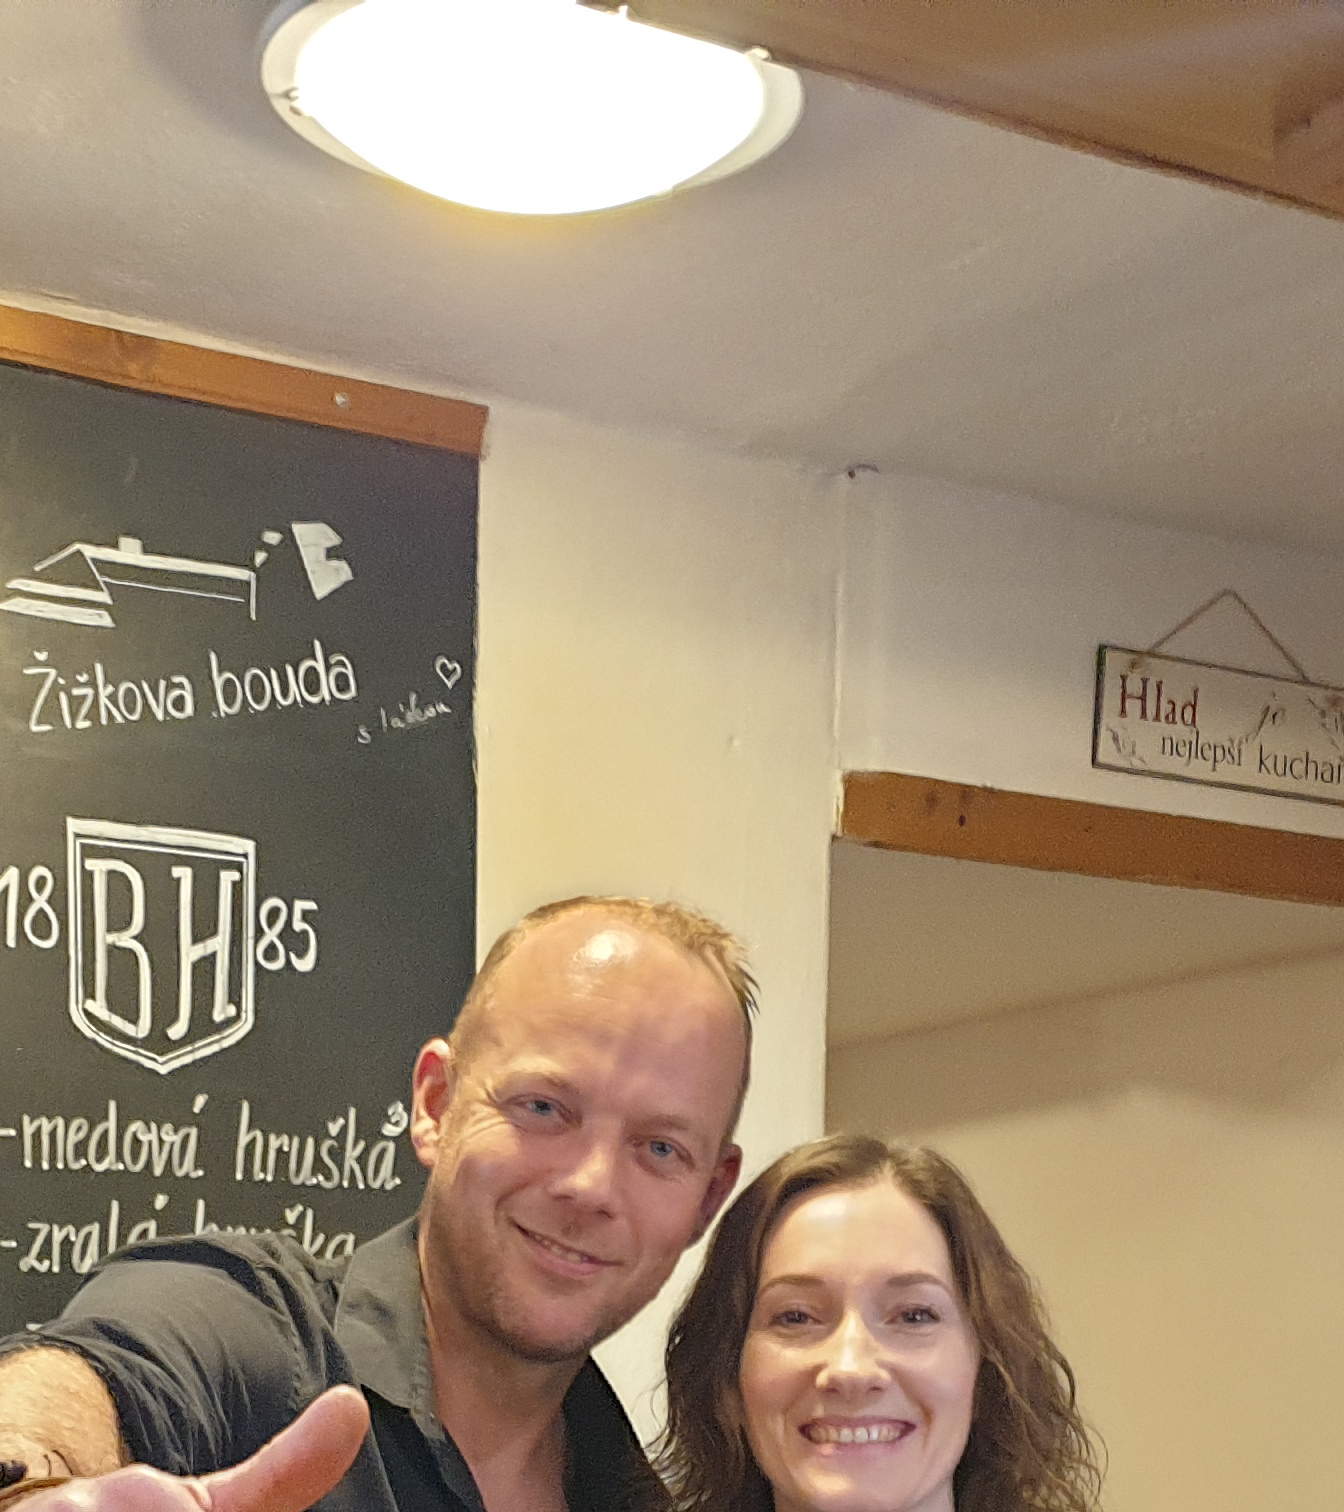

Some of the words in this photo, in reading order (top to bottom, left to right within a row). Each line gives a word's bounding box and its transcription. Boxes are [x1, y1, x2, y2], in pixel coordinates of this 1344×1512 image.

[23, 650, 194, 732] Žižkova
[209, 639, 358, 717] bouda
[1118, 674, 1200, 729] Hlad
[1160, 731, 1249, 773] nejlepší
[84, 856, 242, 1041] BH
[256, 897, 320, 974] 85
